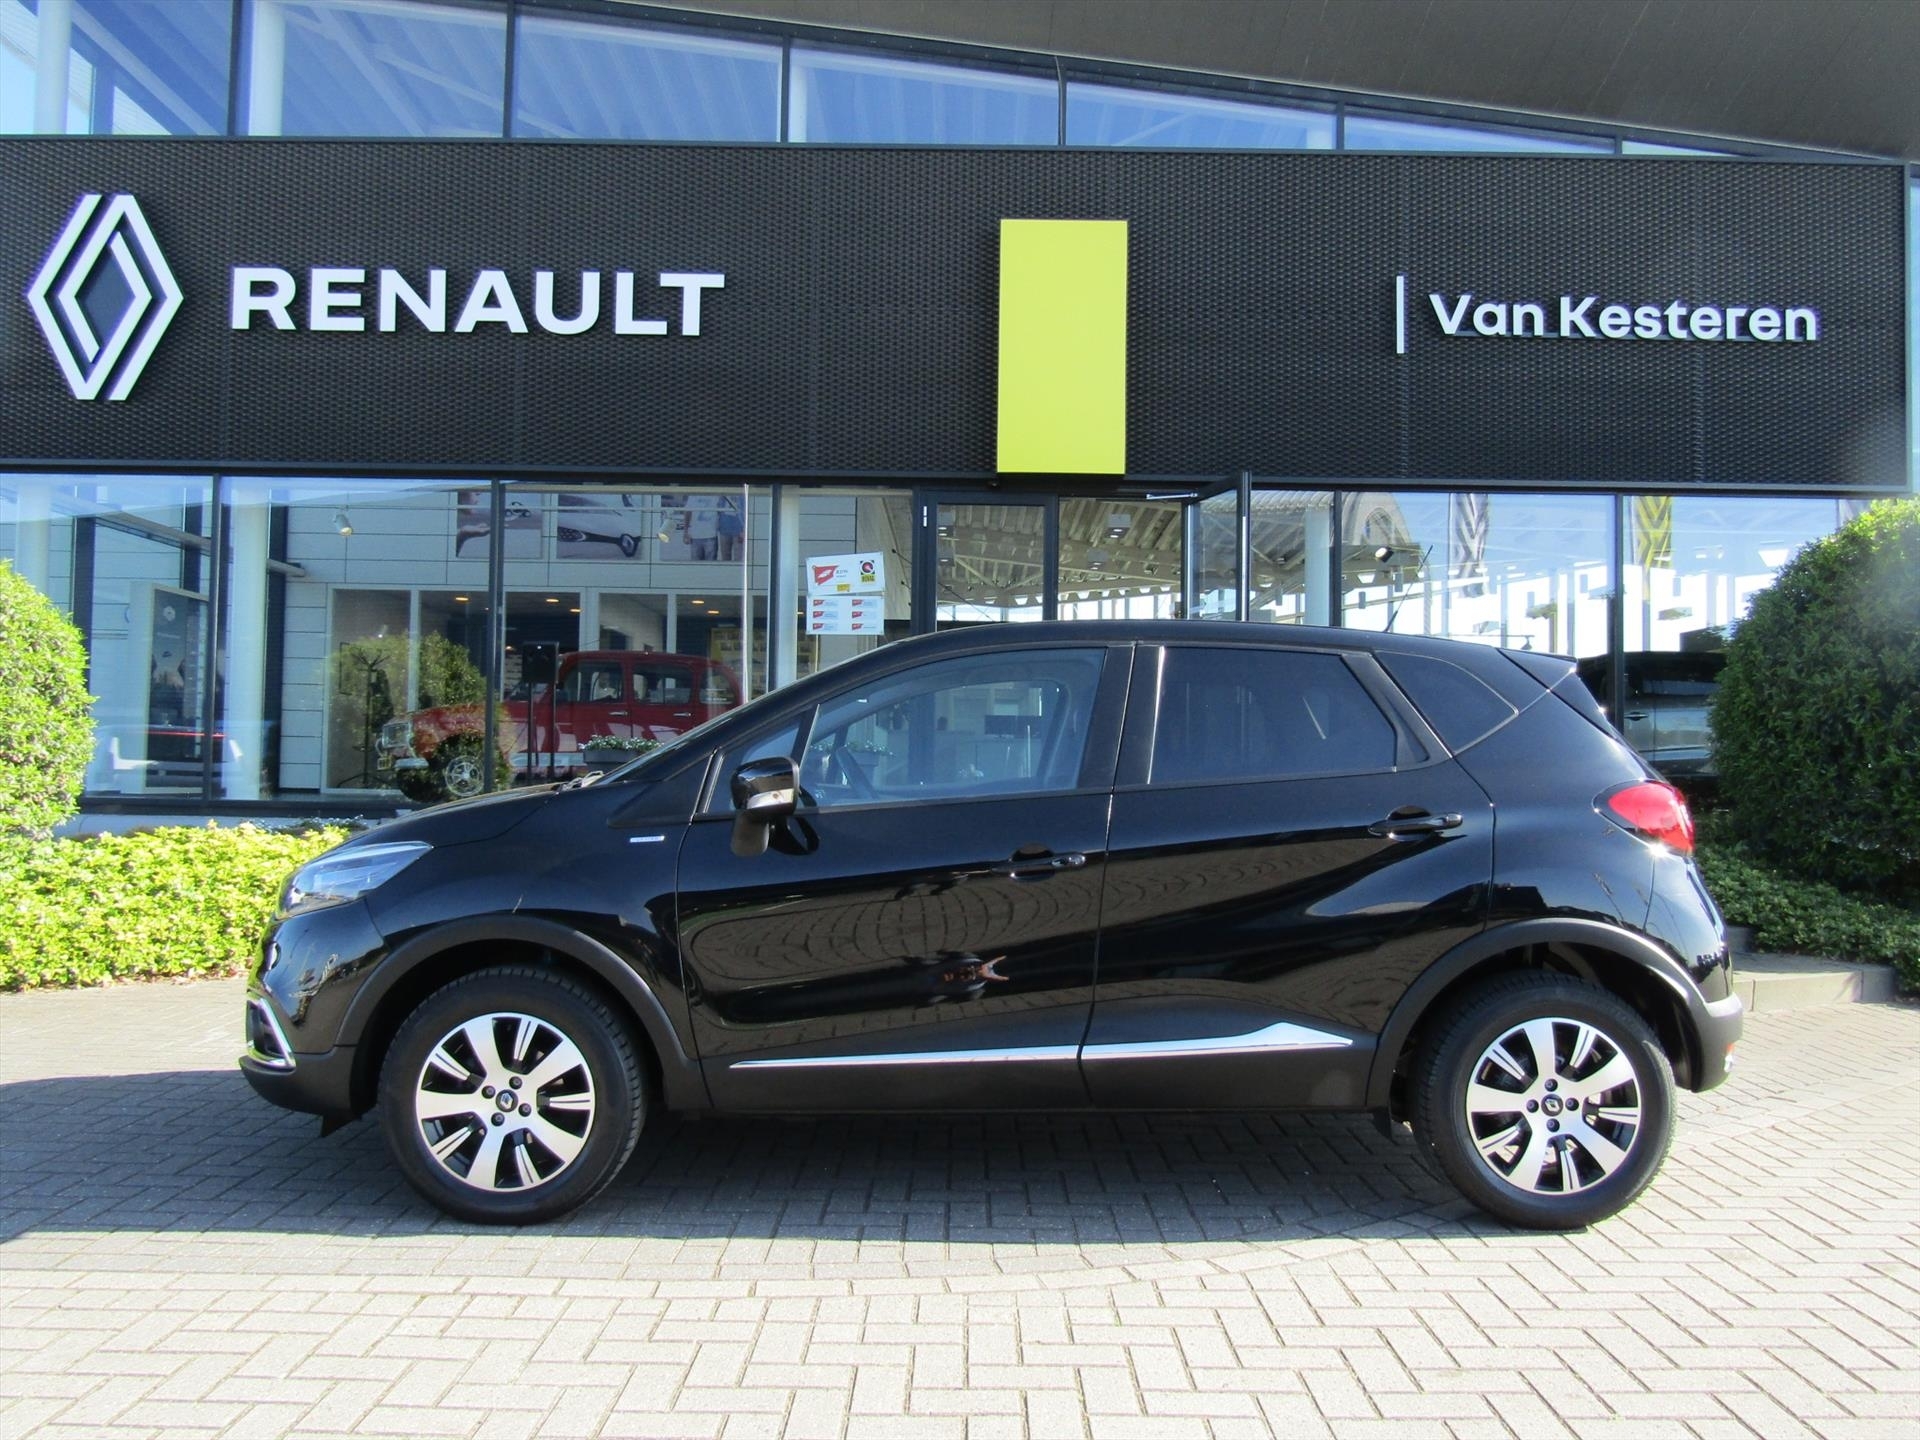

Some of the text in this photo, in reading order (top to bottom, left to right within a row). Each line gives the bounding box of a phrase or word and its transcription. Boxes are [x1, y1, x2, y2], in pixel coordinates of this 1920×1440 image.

[230, 266, 726, 337] RENAULT
[1429, 294, 1818, 341] Van Kesteren
